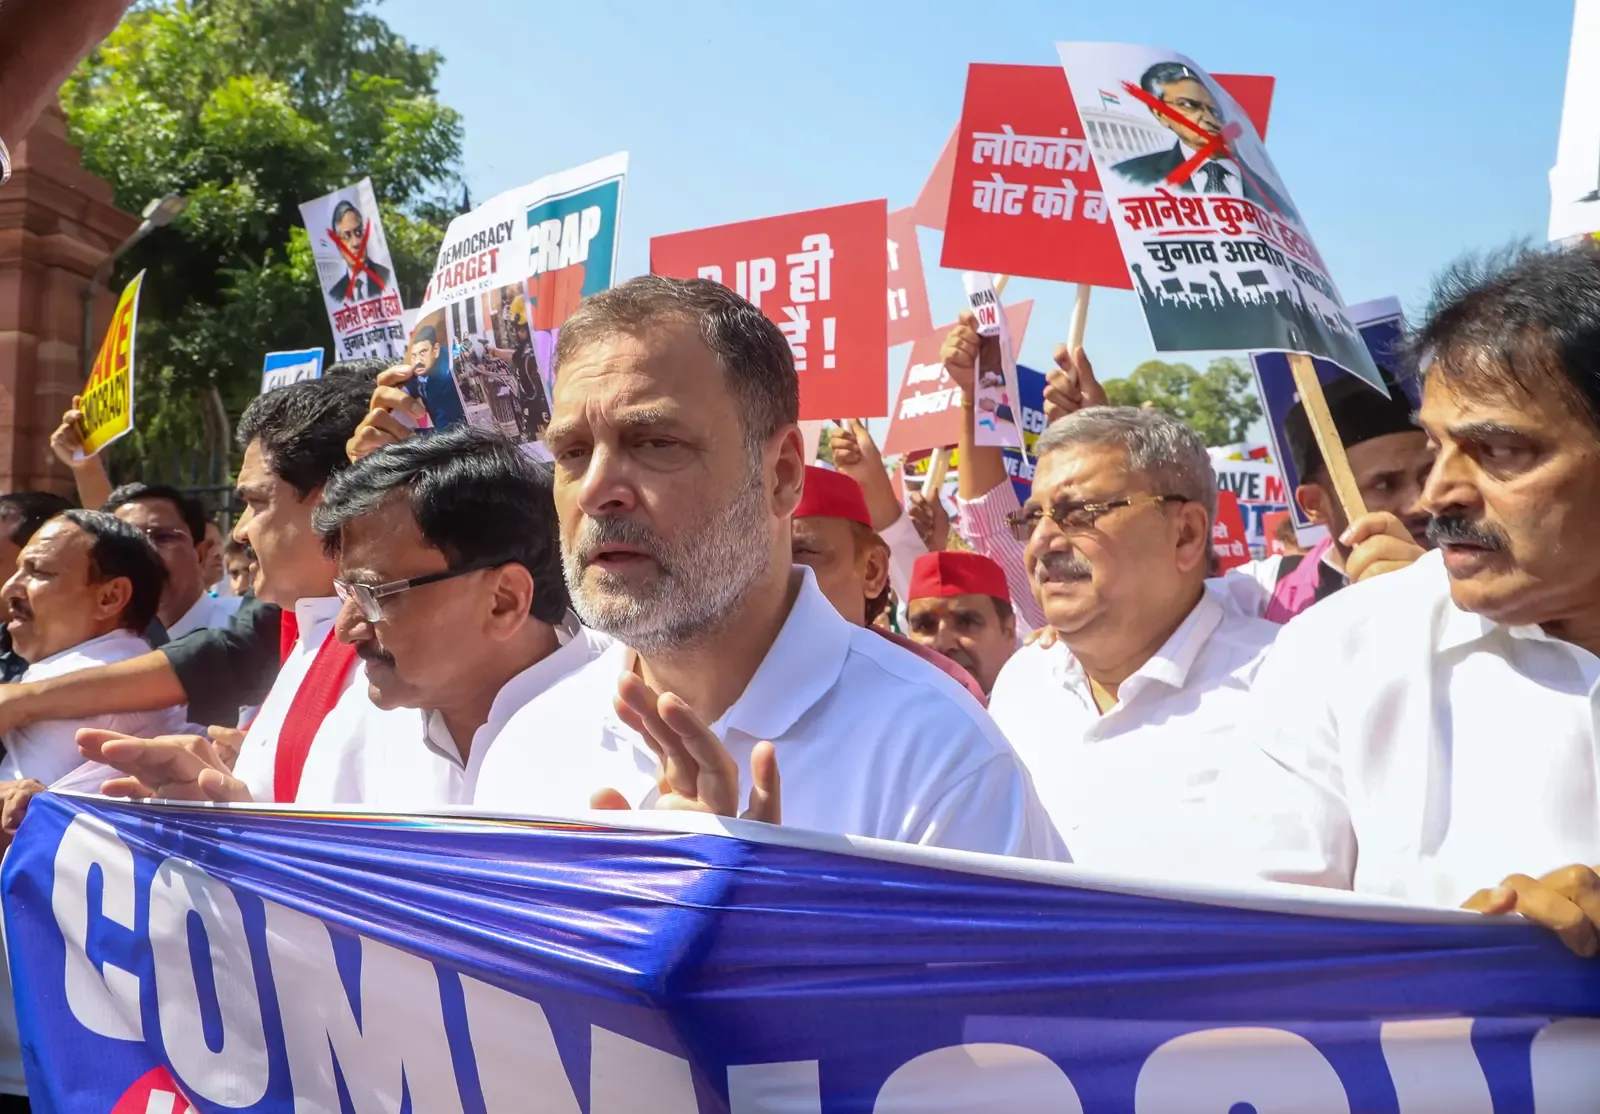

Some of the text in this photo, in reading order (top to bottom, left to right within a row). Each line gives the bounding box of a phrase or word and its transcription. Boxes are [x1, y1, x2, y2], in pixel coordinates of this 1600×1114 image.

[972, 124, 1091, 172] लोकतंत्र
[972, 172, 1028, 215] वोट
[1032, 178, 1079, 220] को
[1118, 187, 1210, 231] ज्ञानेश
[1208, 196, 1279, 241] कुमार
[526, 205, 602, 277] CRAP
[1144, 240, 1219, 272] चुनाव
[1220, 237, 1290, 274] आयोग
[436, 247, 500, 295] TARGET
[786, 233, 834, 302] ही
[969, 289, 996, 308] NDIAN
[1218, 472, 1260, 499] AVE
